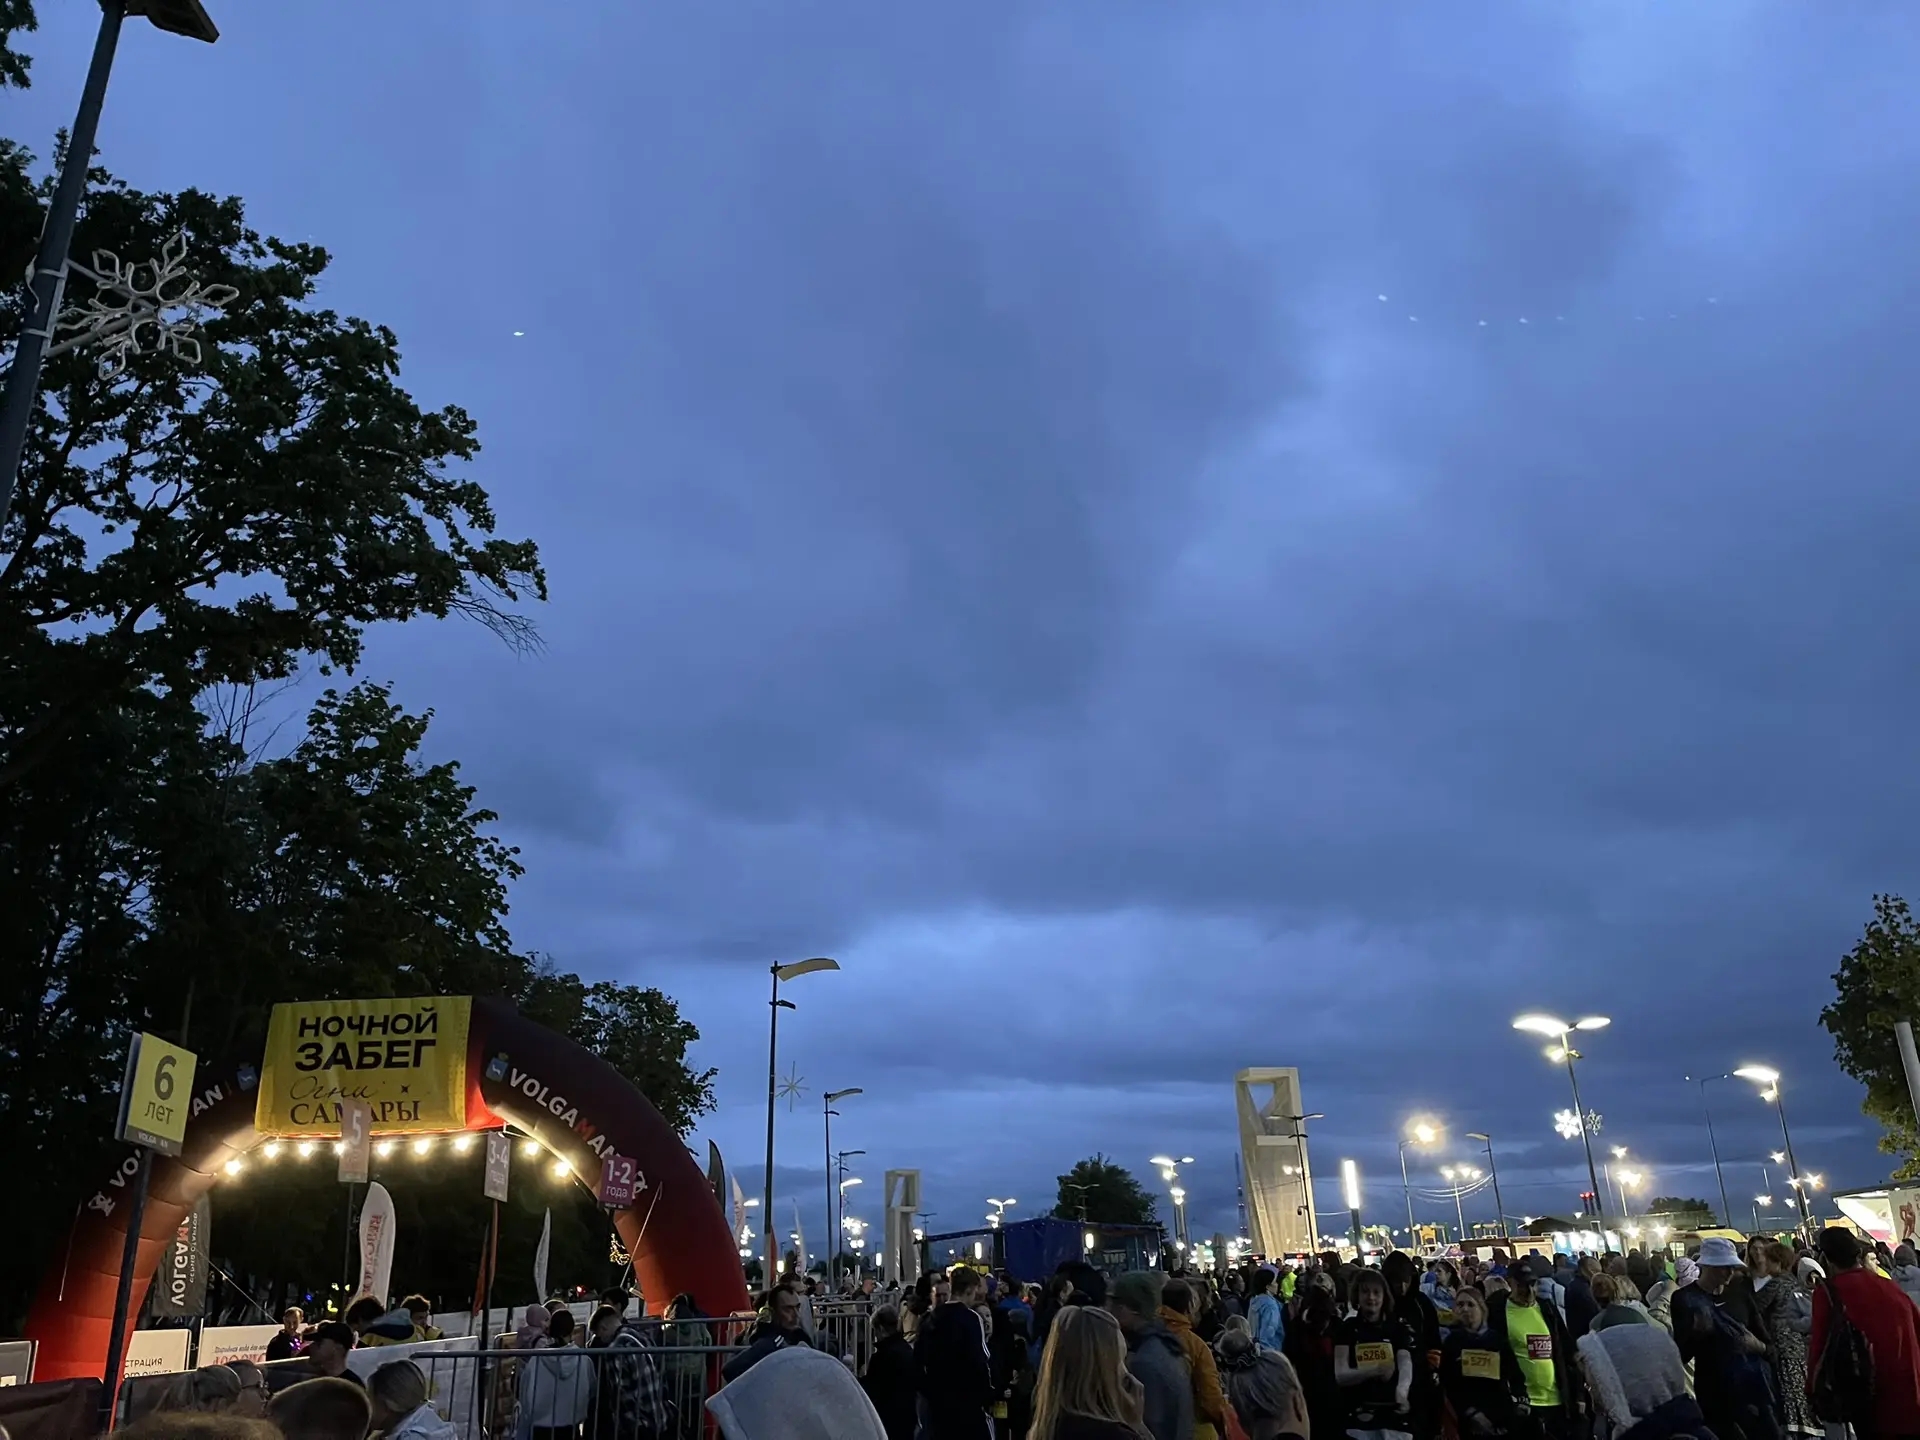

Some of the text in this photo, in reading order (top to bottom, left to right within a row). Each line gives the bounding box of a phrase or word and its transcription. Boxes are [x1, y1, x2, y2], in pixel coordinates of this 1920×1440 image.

[298, 1006, 438, 1038] НОЧНОЙ
[294, 1038, 437, 1072] ЗАБЕГ
[154, 1054, 177, 1101] 6
[144, 1101, 174, 1125] лет
[350, 1109, 362, 1146] 5
[608, 1159, 632, 1185] 1-2
[606, 1185, 629, 1200] года
